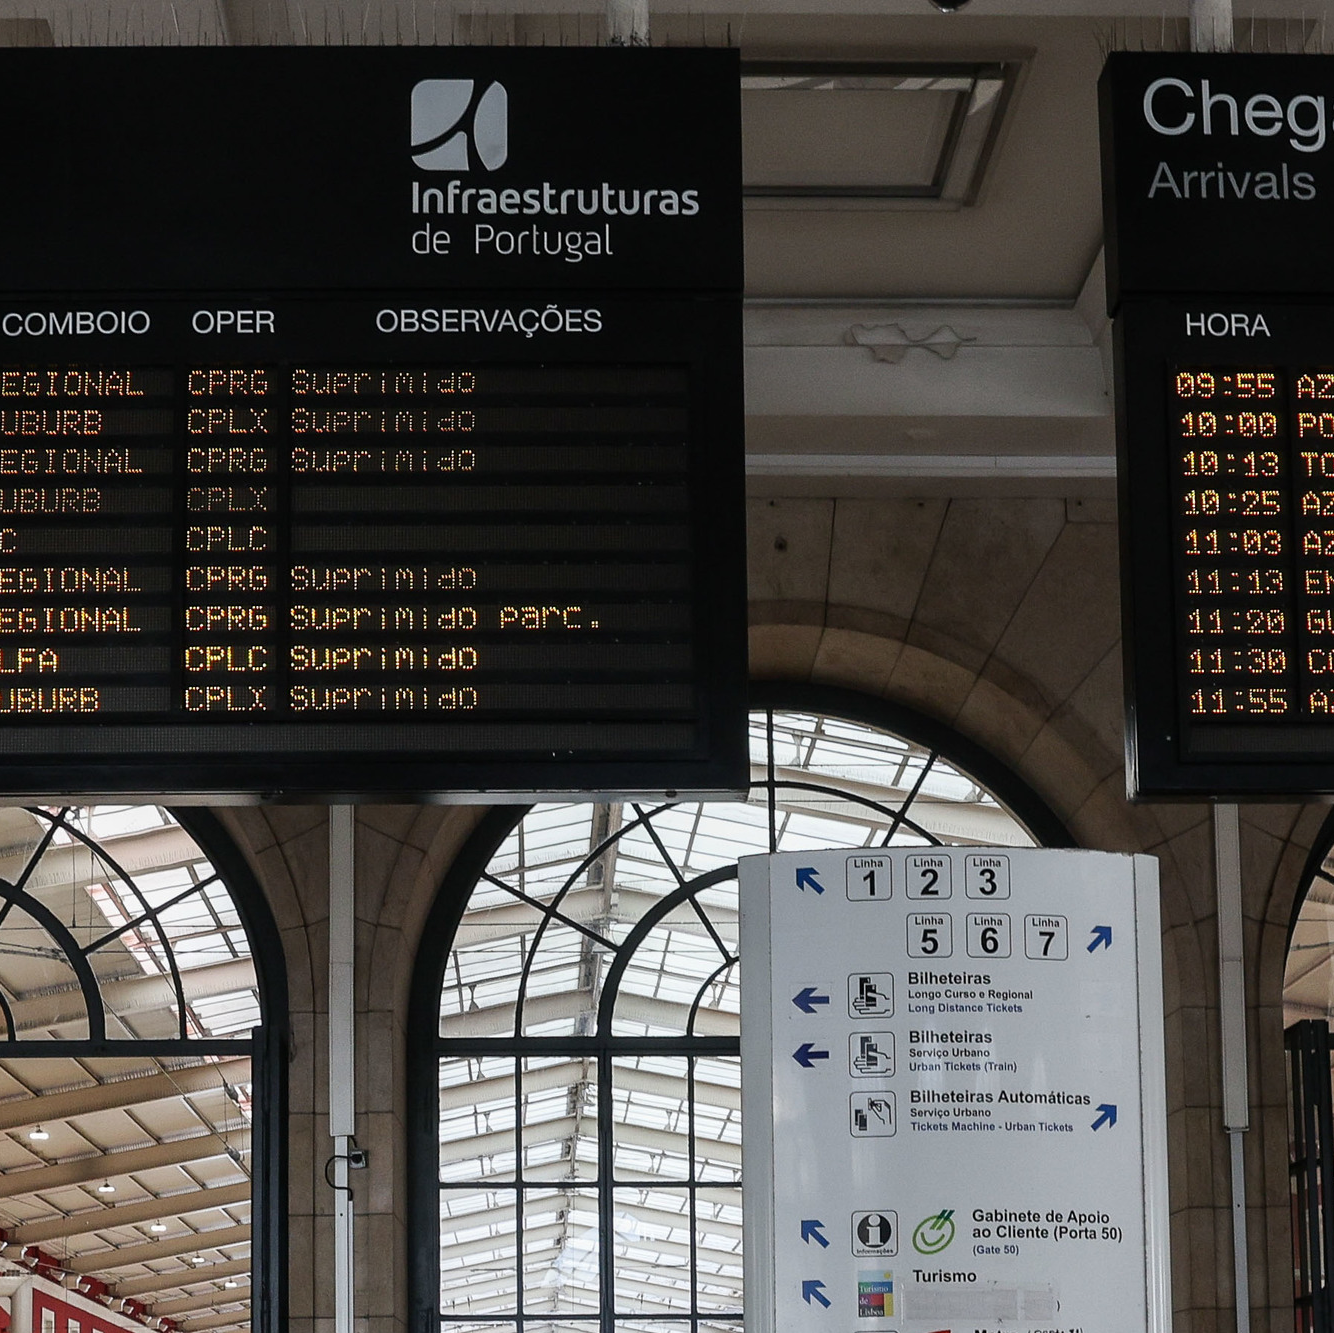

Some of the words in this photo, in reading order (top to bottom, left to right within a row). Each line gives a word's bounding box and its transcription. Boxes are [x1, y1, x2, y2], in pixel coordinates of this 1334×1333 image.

[1149, 162, 1315, 199] Arrivals
[413, 180, 699, 215] Infraestruturas
[413, 223, 450, 254] de
[476, 224, 613, 262] Portugal
[3, 311, 150, 336] COMBOIO
[193, 311, 274, 333] OPER
[377, 305, 602, 338] OBSERVAÇÕES
[1187, 313, 1270, 336] HORA
[189, 370, 267, 395] CPRG
[292, 370, 475, 394] Suprimido
[1182, 412, 1276, 438] 10:00
[187, 526, 266, 551] CPLC
[186, 566, 267, 590] CPRG
[291, 566, 476, 590] Suprimido
[1188, 570, 1283, 594] 11:13
[186, 606, 267, 631] CPRG
[291, 606, 476, 630] Suprimido
[500, 607, 598, 629] parc.
[186, 646, 266, 671] CPLC
[291, 646, 477, 670] Suprimido
[1192, 689, 1287, 713] 11:55
[854, 859, 883, 868] Linha
[914, 858, 943, 867] Linha
[973, 858, 1001, 867] Linha
[863, 870, 875, 896] 1
[921, 869, 938, 895] 2
[979, 869, 997, 895] 3
[915, 916, 943, 925] Linha
[975, 917, 1002, 926] Linha
[1032, 918, 1059, 927] Linha
[922, 929, 938, 954] 5
[981, 927, 998, 953] 6
[1039, 931, 1055, 956] 7
[909, 972, 990, 984] Bilheteiras
[909, 990, 941, 1000] Longo
[945, 989, 976, 998] Curso
[988, 990, 1032, 1001] Regional
[909, 1004, 934, 1014] Long
[939, 1003, 983, 1012] Distance
[987, 1003, 1022, 1012] Tickets
[910, 1030, 992, 1043] Bilheteiras
[909, 1048, 948, 1058] Serviço
[952, 1048, 990, 1057] Urbano
[910, 1062, 940, 1071] Urban
[944, 1062, 980, 1071] Tickets
[985, 1062, 1017, 1073] (Train)
[911, 1090, 993, 1103] Bilheteiras
[998, 1090, 1090, 1105] Automáticas
[911, 1108, 950, 1119] Serviço
[953, 1108, 991, 1117] Urbano
[911, 1122, 948, 1131] Tickets
[952, 1122, 995, 1131] Machine
[1005, 1122, 1035, 1131] Urban
[1039, 1122, 1073, 1132] Tickets
[973, 1209, 1040, 1222] Gabinete
[1046, 1210, 1063, 1222] de
[1067, 1210, 1109, 1226] Apoio
[973, 1228, 991, 1238] ao
[997, 1225, 1048, 1238] Cliente
[1054, 1226, 1096, 1241] (Porta
[1102, 1227, 1122, 1243] 50)
[973, 1245, 1000, 1256] (Gate
[1004, 1245, 1019, 1256] 50)
[913, 1269, 976, 1282] Turismo
